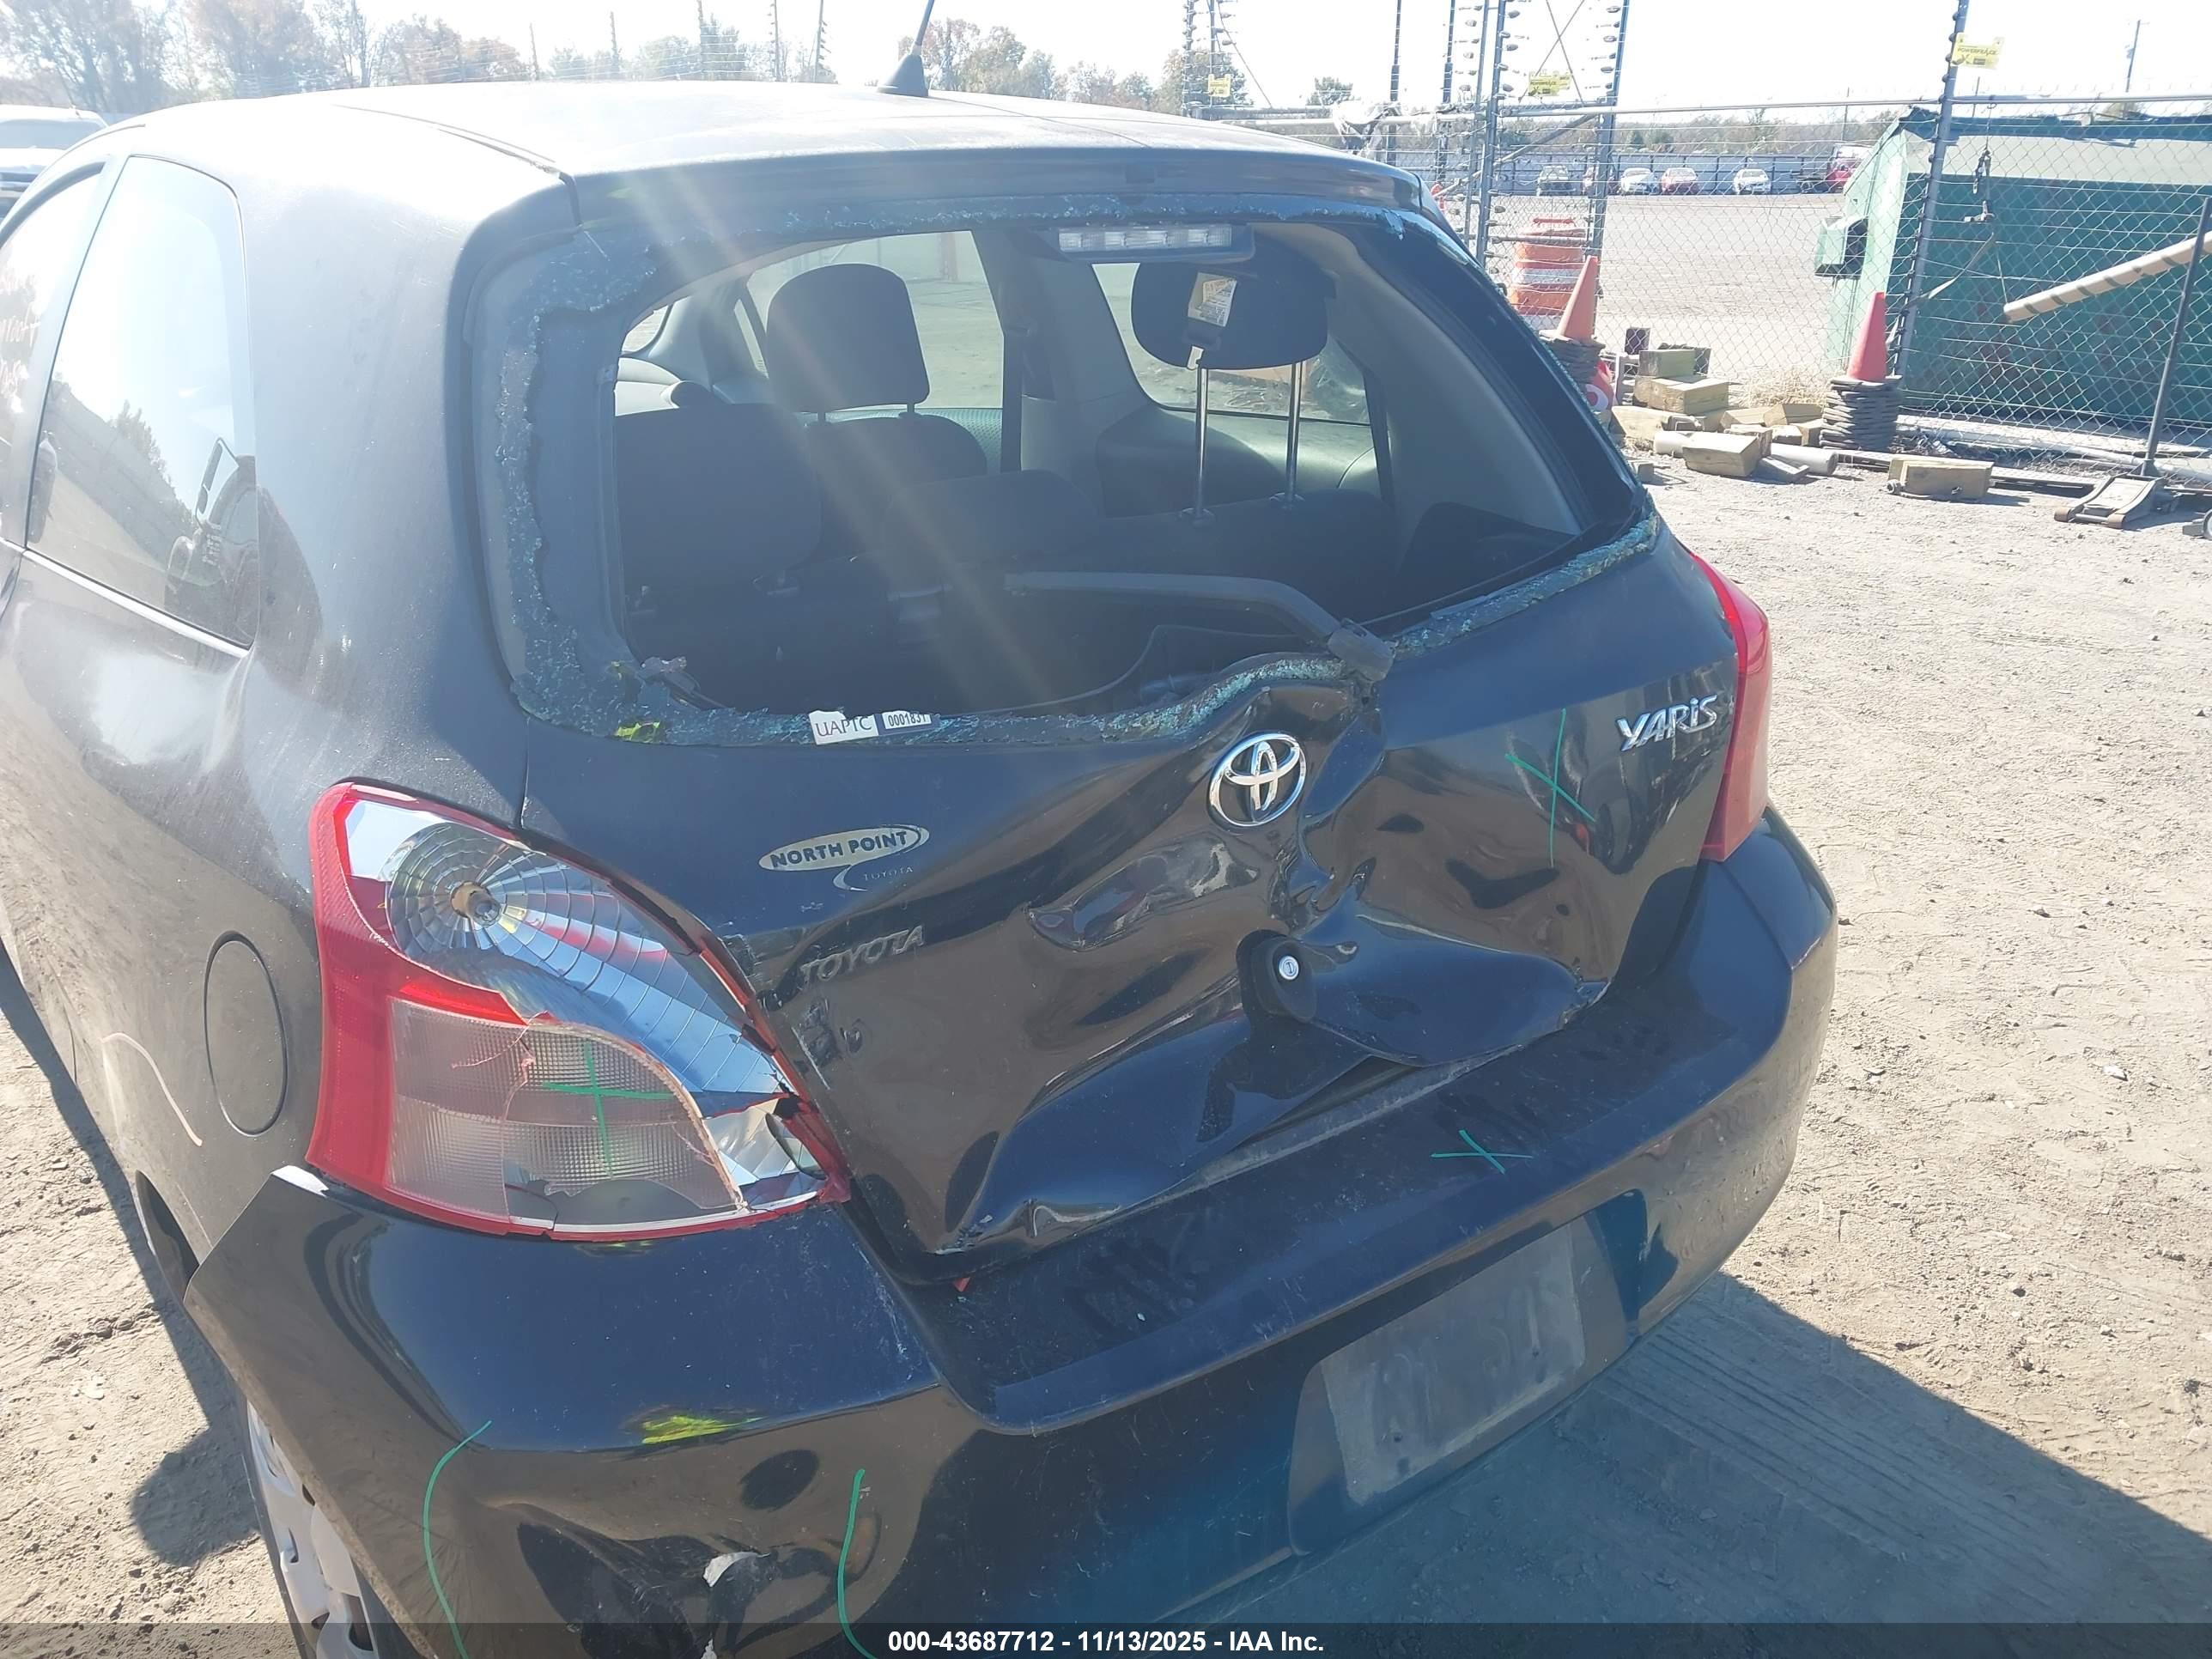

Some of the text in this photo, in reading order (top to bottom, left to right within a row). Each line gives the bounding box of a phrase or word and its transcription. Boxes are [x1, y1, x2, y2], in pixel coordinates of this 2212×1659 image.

[769, 830, 908, 868] NORTH POINT
[799, 924, 925, 988] TOYOTA
